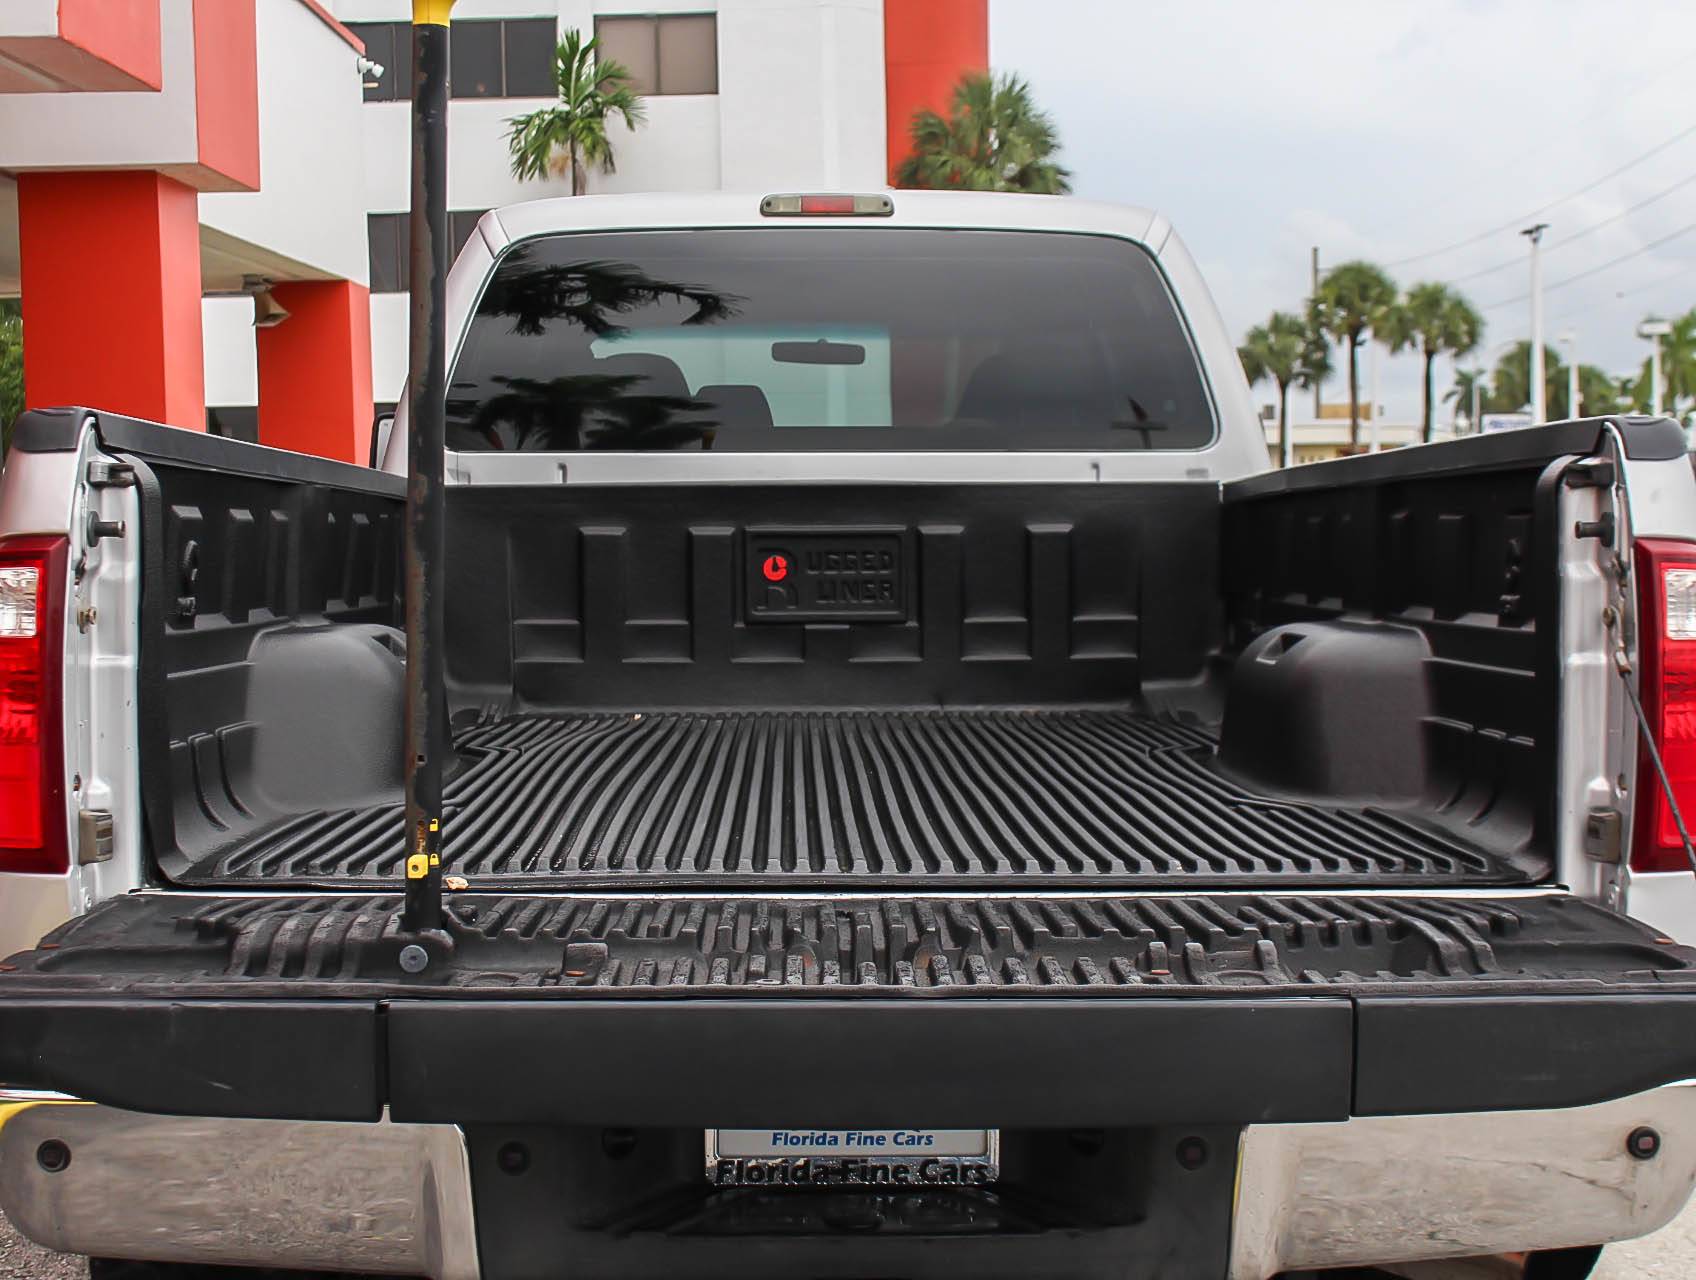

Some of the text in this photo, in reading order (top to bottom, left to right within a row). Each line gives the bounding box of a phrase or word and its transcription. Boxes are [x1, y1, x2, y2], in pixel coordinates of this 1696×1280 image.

[815, 580, 895, 604] LINER
[771, 1131, 934, 1147] Florida Fine Cars
[715, 1157, 990, 1185] Florida Fine Cars
